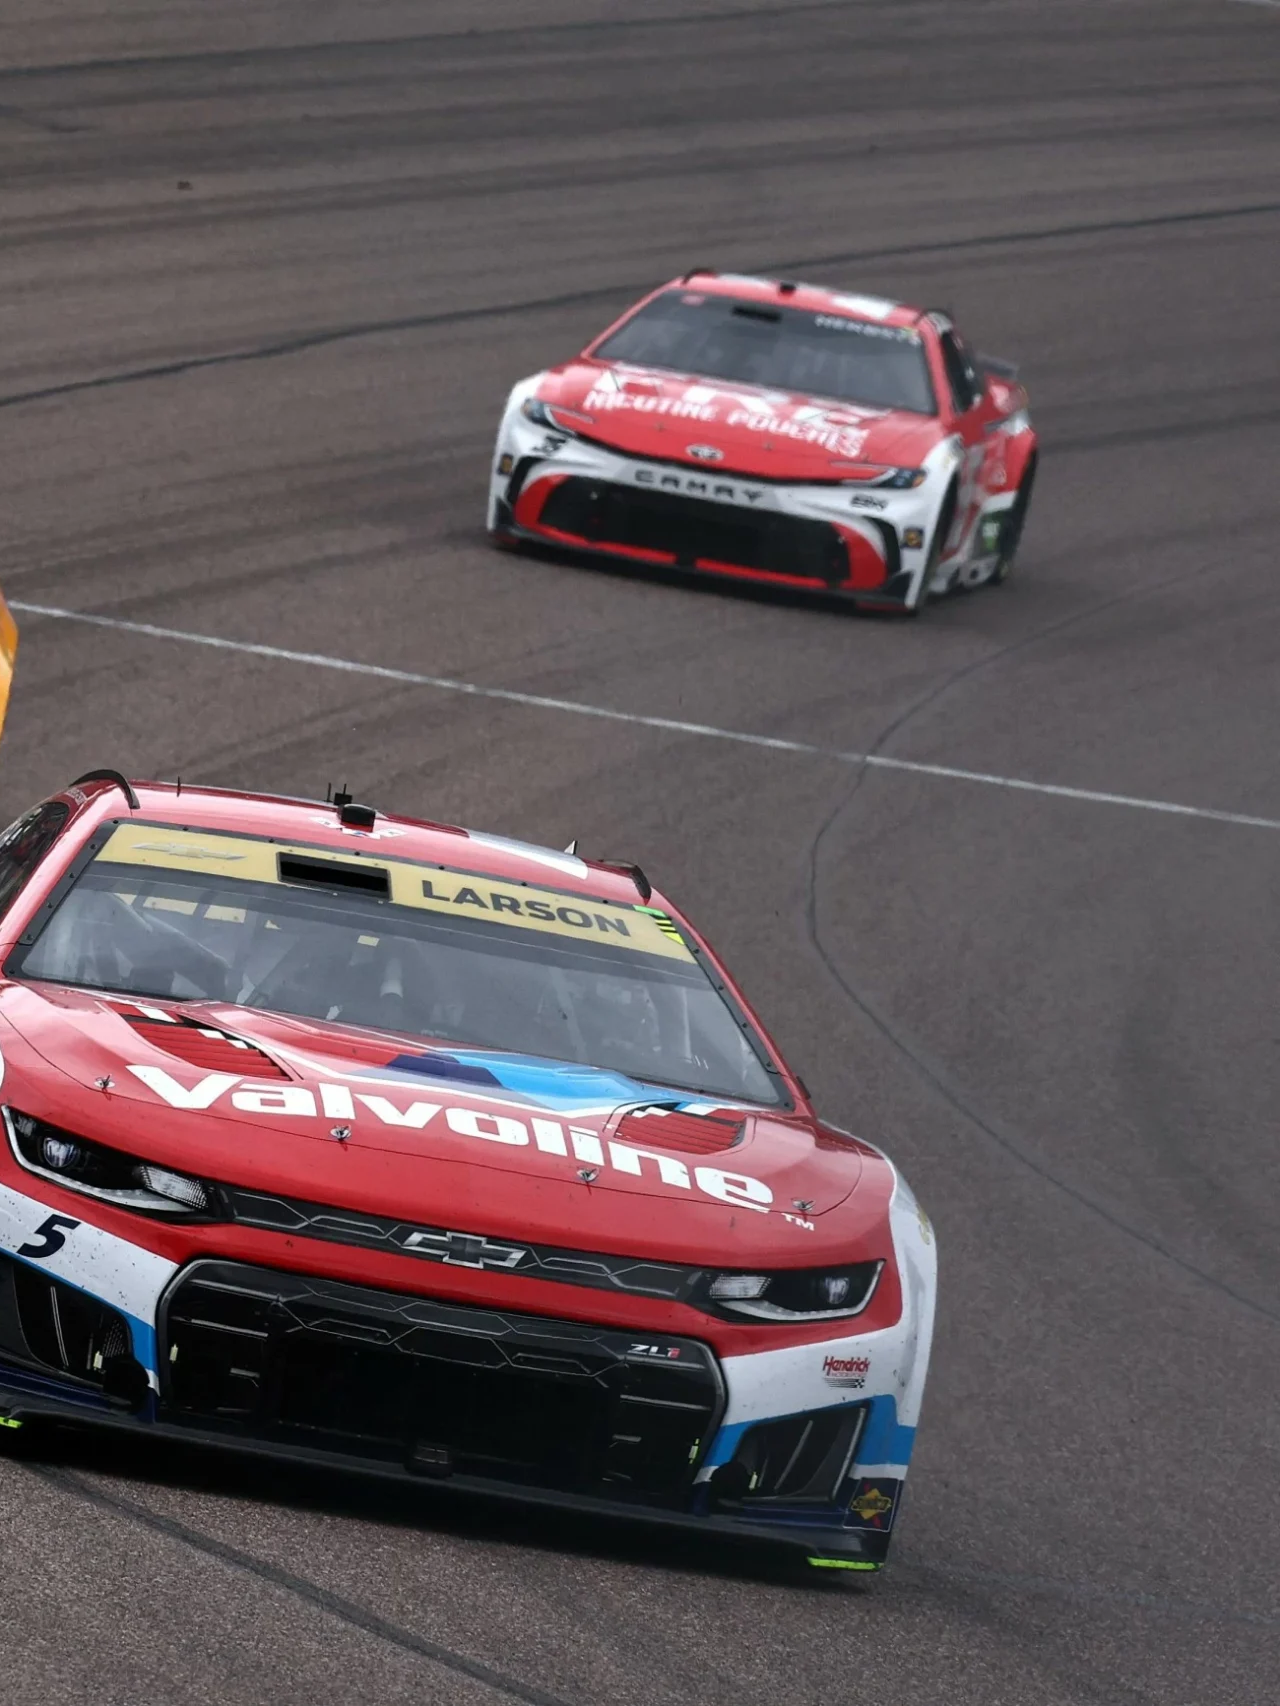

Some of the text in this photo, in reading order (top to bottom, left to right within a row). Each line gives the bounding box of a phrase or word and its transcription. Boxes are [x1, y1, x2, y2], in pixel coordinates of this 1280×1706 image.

[634, 469, 763, 503] CAMRY
[421, 880, 632, 937] LARSON
[125, 1063, 776, 1214] Valvoline
[16, 1214, 82, 1259] 5
[822, 1355, 870, 1376] Hendrick
